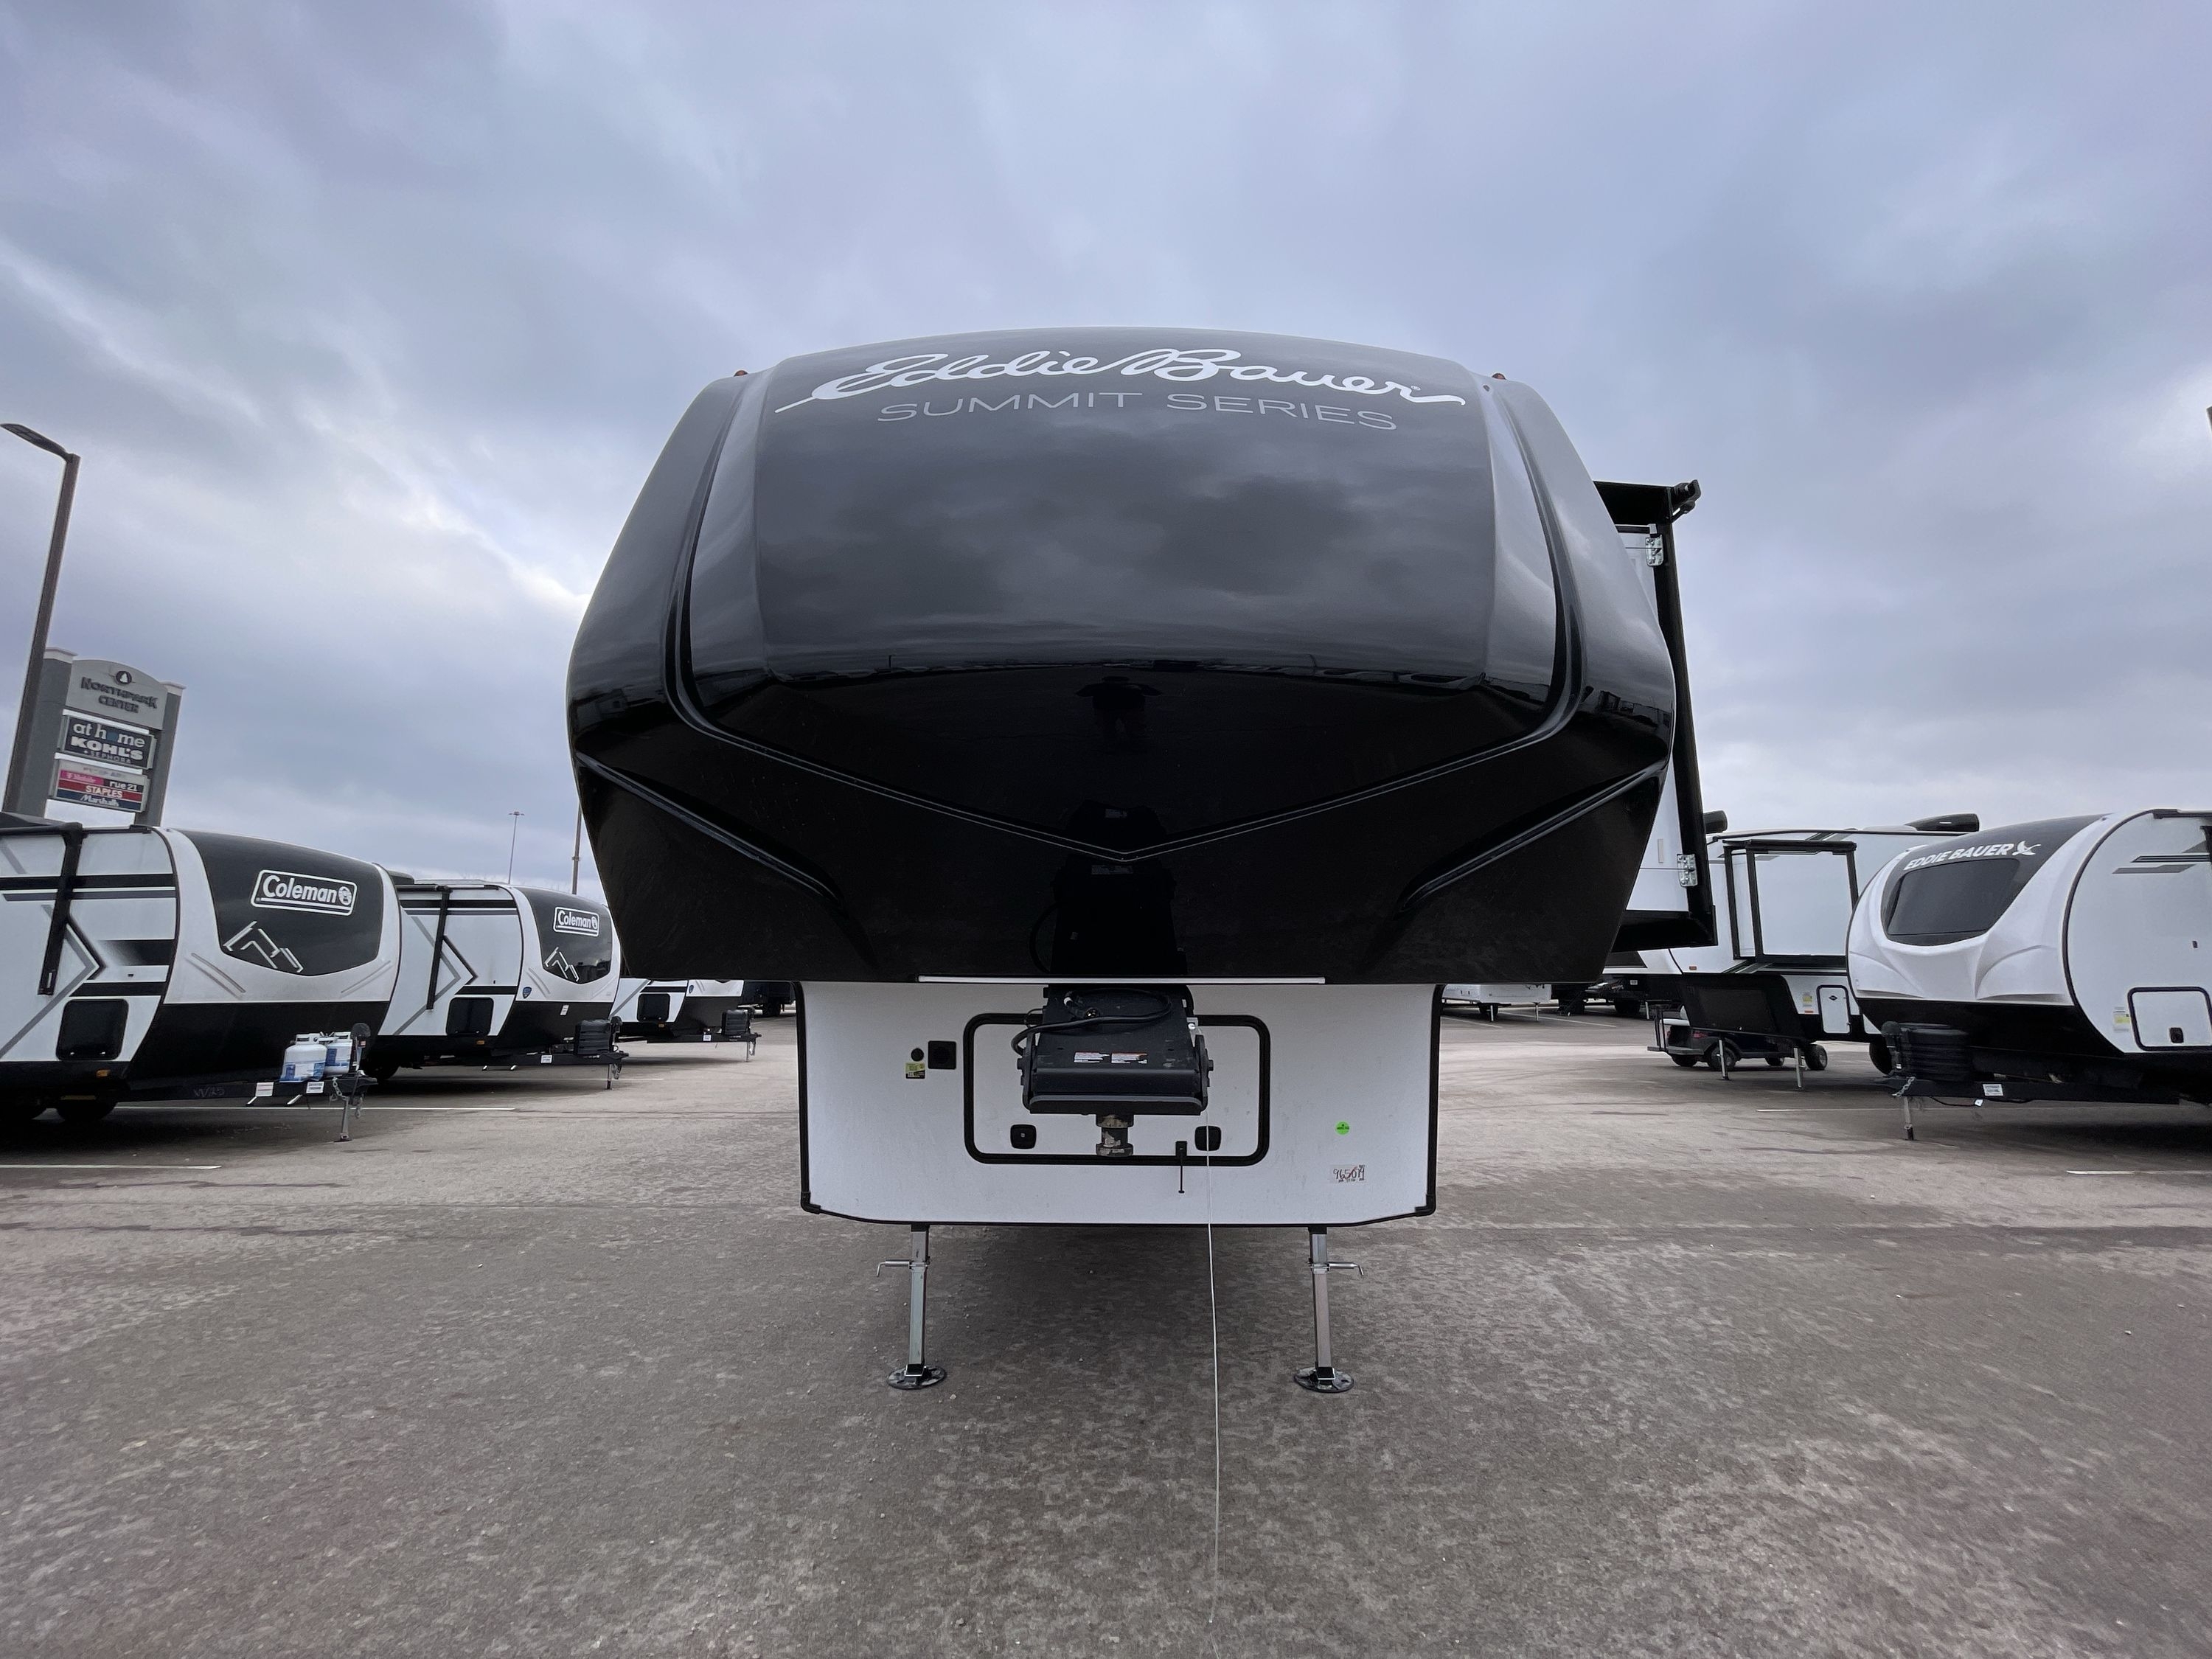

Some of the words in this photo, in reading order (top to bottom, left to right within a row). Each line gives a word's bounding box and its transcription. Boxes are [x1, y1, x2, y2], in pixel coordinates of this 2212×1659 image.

[775, 350, 1115, 413] Eddie
[1117, 348, 1466, 406] Bauer
[877, 392, 1143, 421] SUMMIT
[1167, 393, 1397, 431] SERIES
[73, 723, 93, 736] at
[71, 736, 143, 760] KOHL'S
[90, 751, 131, 764] SEPHORA
[86, 785, 123, 799] STAPLES
[109, 781, 126, 790] rue
[128, 783, 138, 792] 21
[1904, 850, 1952, 871] EDDIE
[1948, 844, 2014, 860] BAUER
[262, 874, 338, 903] Coleman
[557, 910, 591, 929] Coleman
